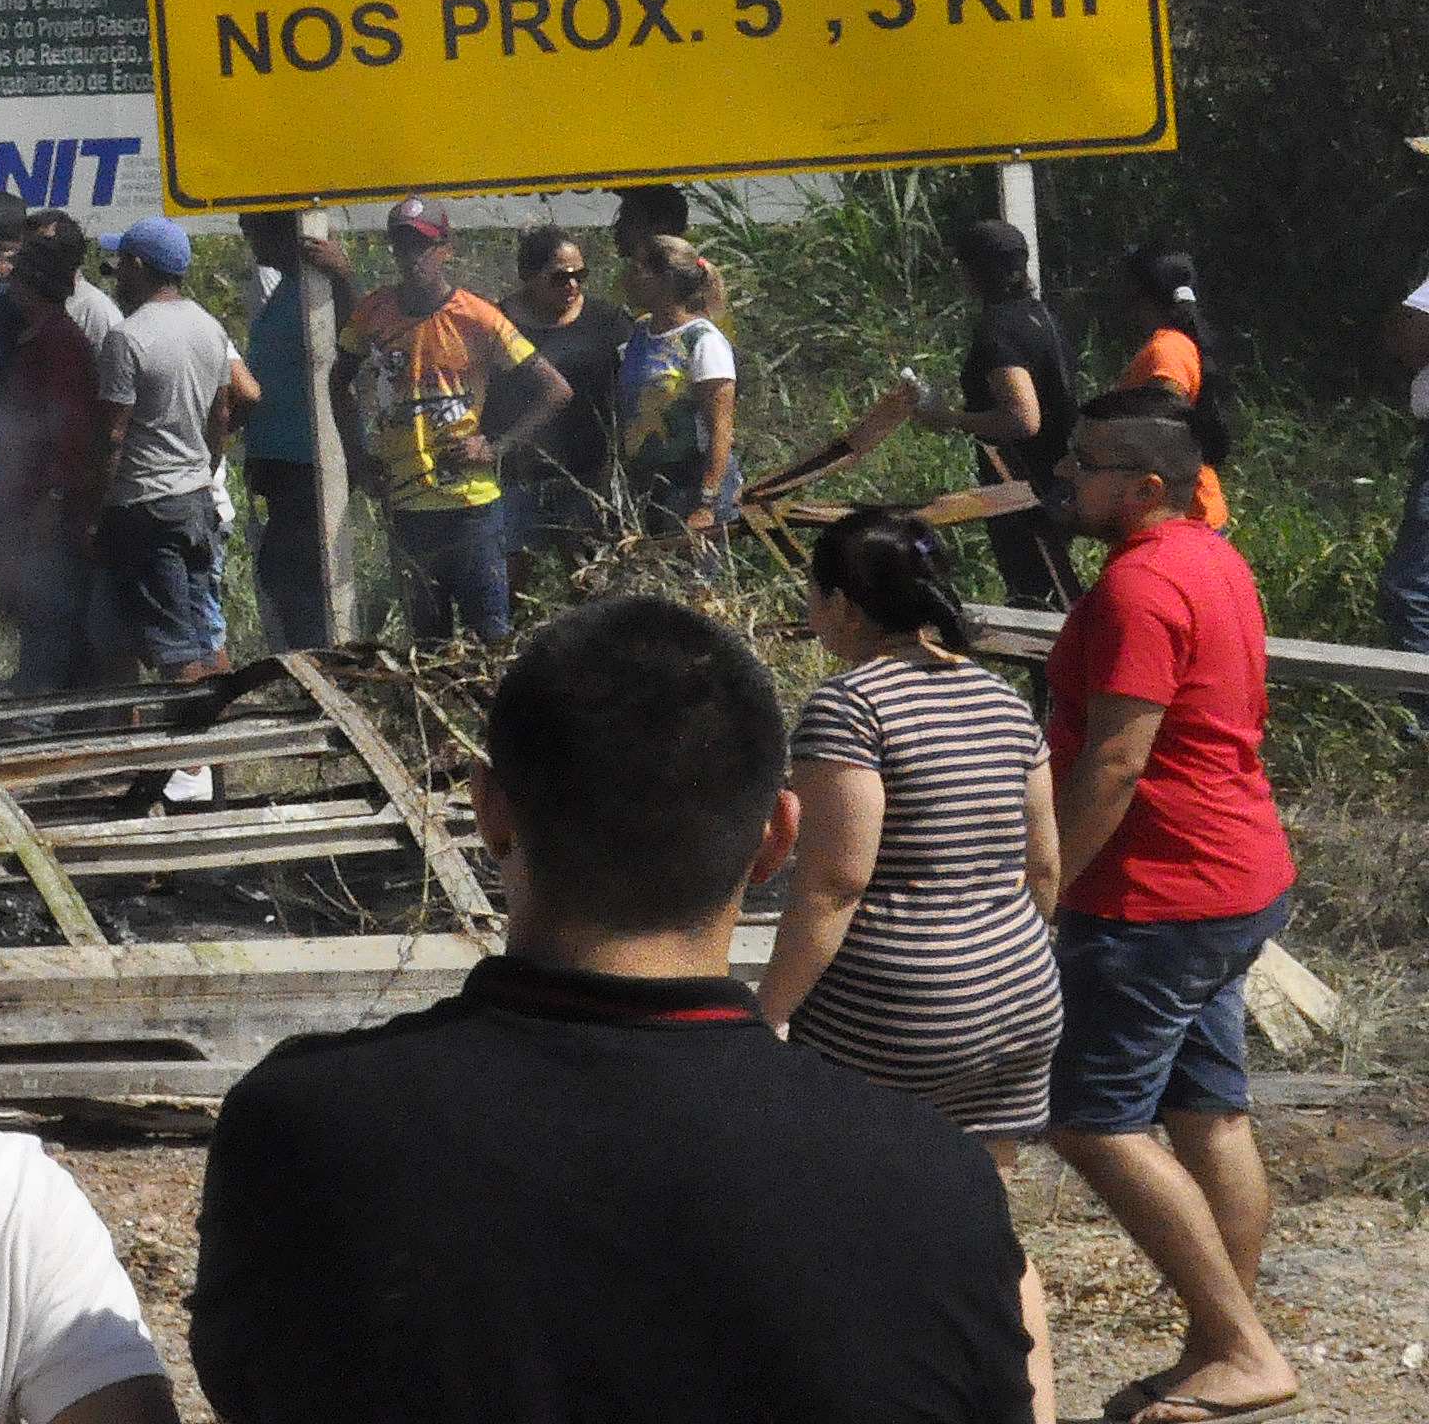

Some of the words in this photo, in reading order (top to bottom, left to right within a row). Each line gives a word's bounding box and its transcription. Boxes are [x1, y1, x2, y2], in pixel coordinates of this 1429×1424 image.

[14, 17, 35, 39] do
[37, 16, 95, 43] Projeto
[216, 2, 403, 77] NOS
[15, 43, 36, 67] de
